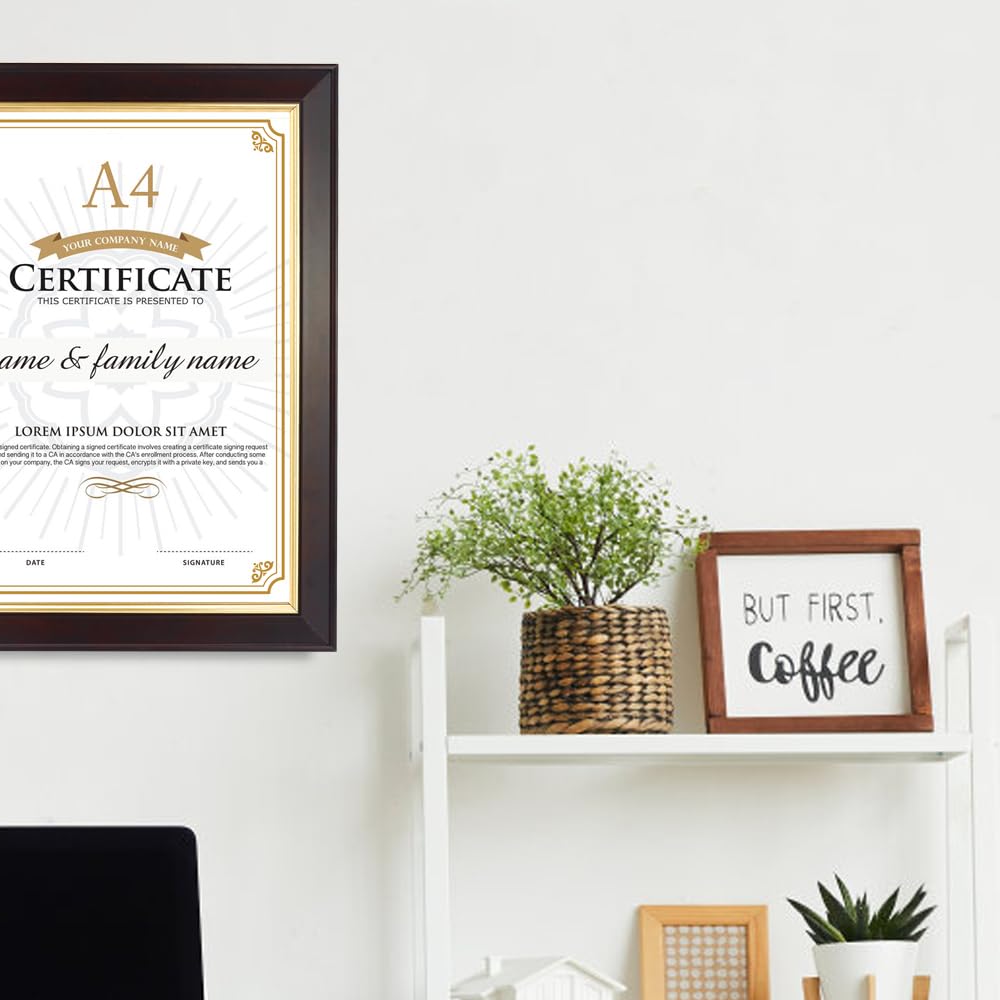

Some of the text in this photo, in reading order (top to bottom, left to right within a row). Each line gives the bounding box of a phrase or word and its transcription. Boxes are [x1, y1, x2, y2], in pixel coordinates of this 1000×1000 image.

[82, 160, 159, 208] A4
[62, 235, 179, 253] YOUR COMPANY NAME
[9, 263, 232, 293] CERTIFICATE
[37, 297, 204, 305] THIS CERTIFICATE IS PRESENTED TO
[60, 345, 90, 370] &
[89, 343, 186, 380] family
[186, 354, 260, 370] name
[15, 426, 227, 437] LOREM IPSUM DOLOR SIT AMET
[742, 593, 790, 625] BUT
[748, 640, 885, 703] Coffee
